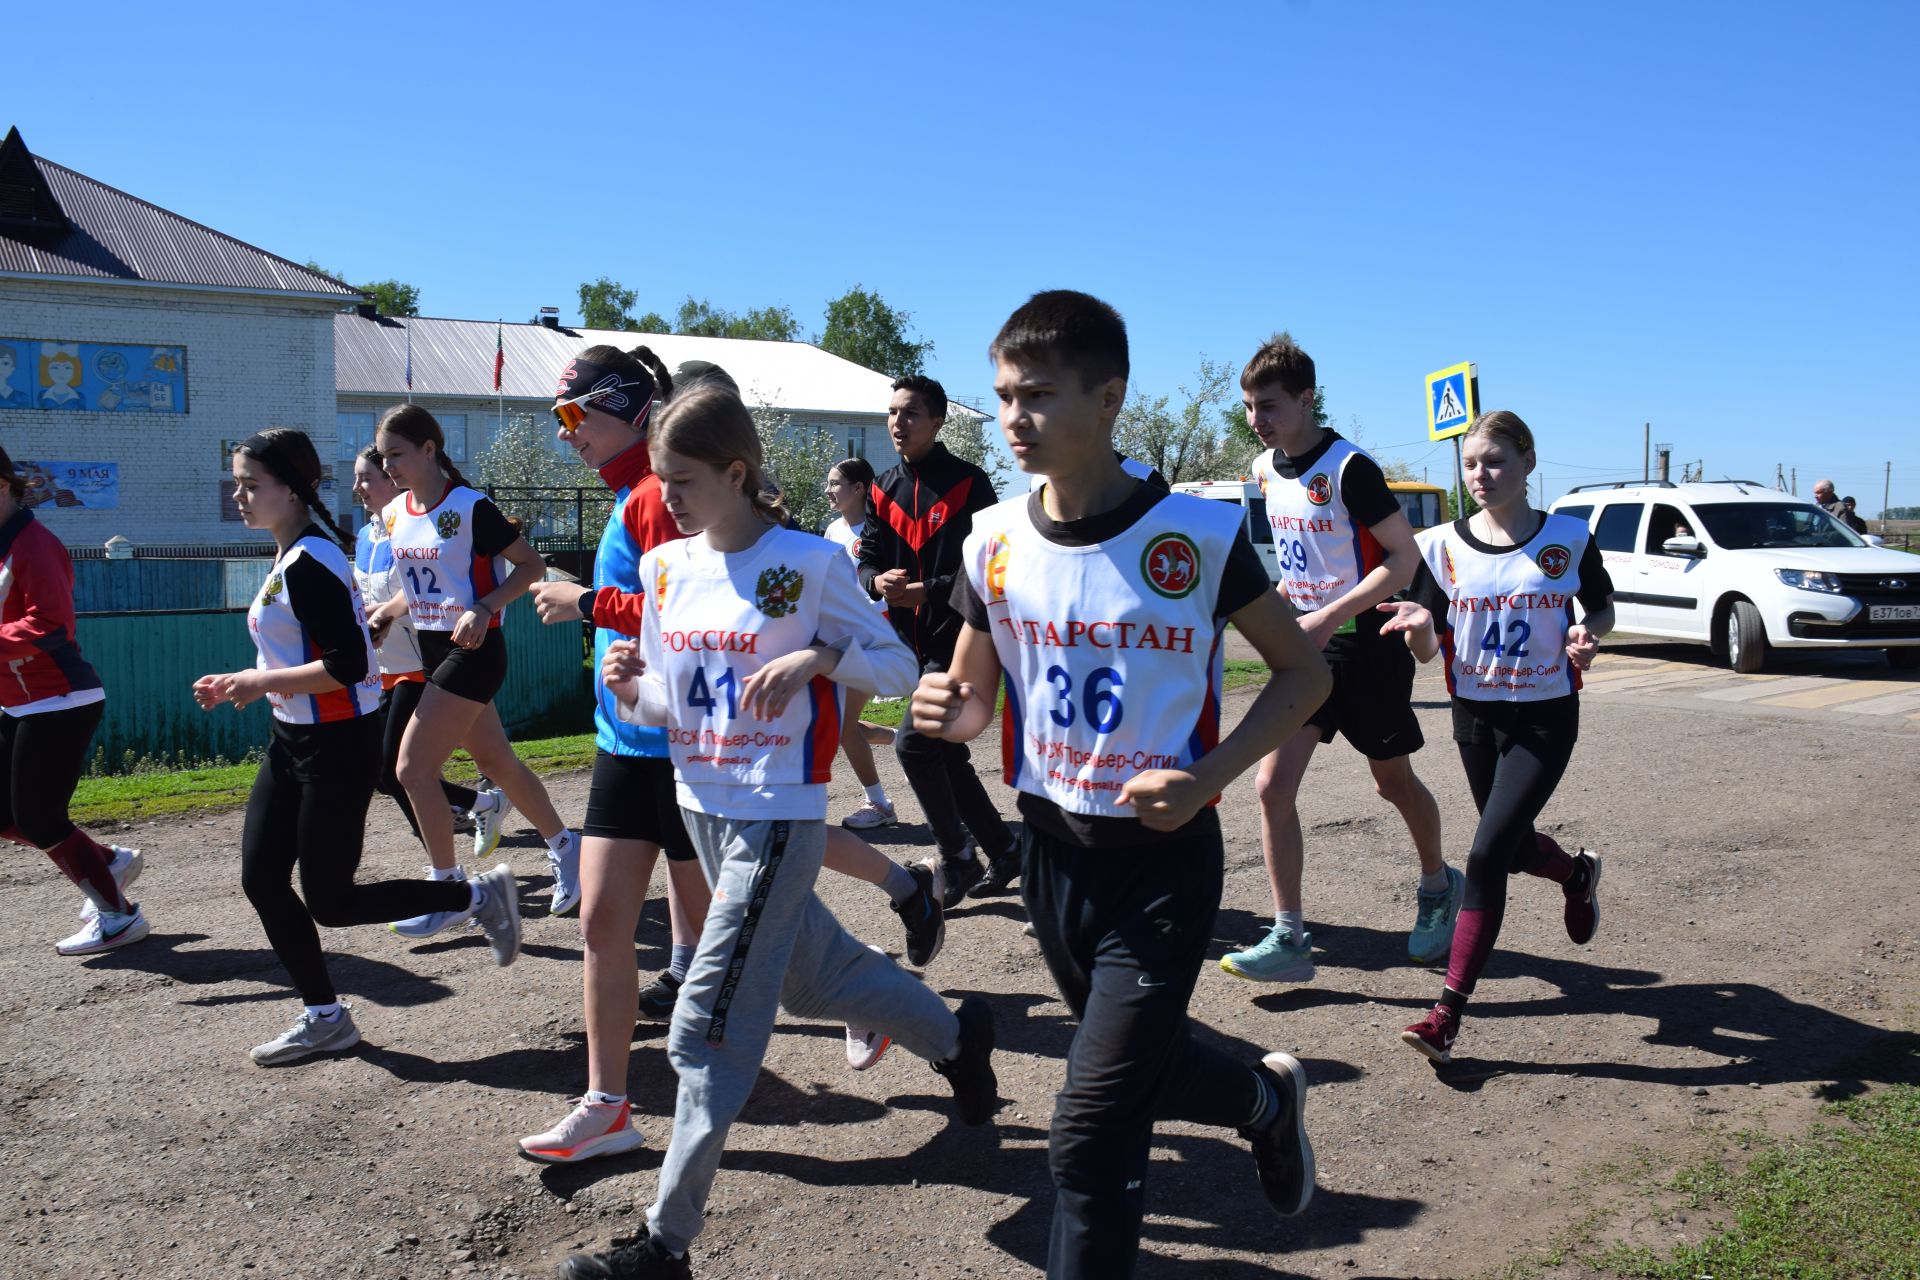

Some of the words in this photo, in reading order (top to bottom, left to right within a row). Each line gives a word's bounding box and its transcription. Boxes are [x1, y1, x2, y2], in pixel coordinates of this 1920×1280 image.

[67, 469, 76, 478] 9
[80, 469, 109, 479] МАЯ
[1270, 515, 1334, 532] ТАРСТАН
[1279, 538, 1307, 573] 39
[406, 566, 441, 594] 12
[662, 630, 759, 654] РОССИЯ
[998, 618, 1195, 653] ТТАРСТАН
[1481, 620, 1531, 657] 42
[687, 666, 736, 719] 41
[1047, 665, 1123, 734] 36
[740, 914, 758, 945] AGE
[717, 957, 744, 1011] SPACE
